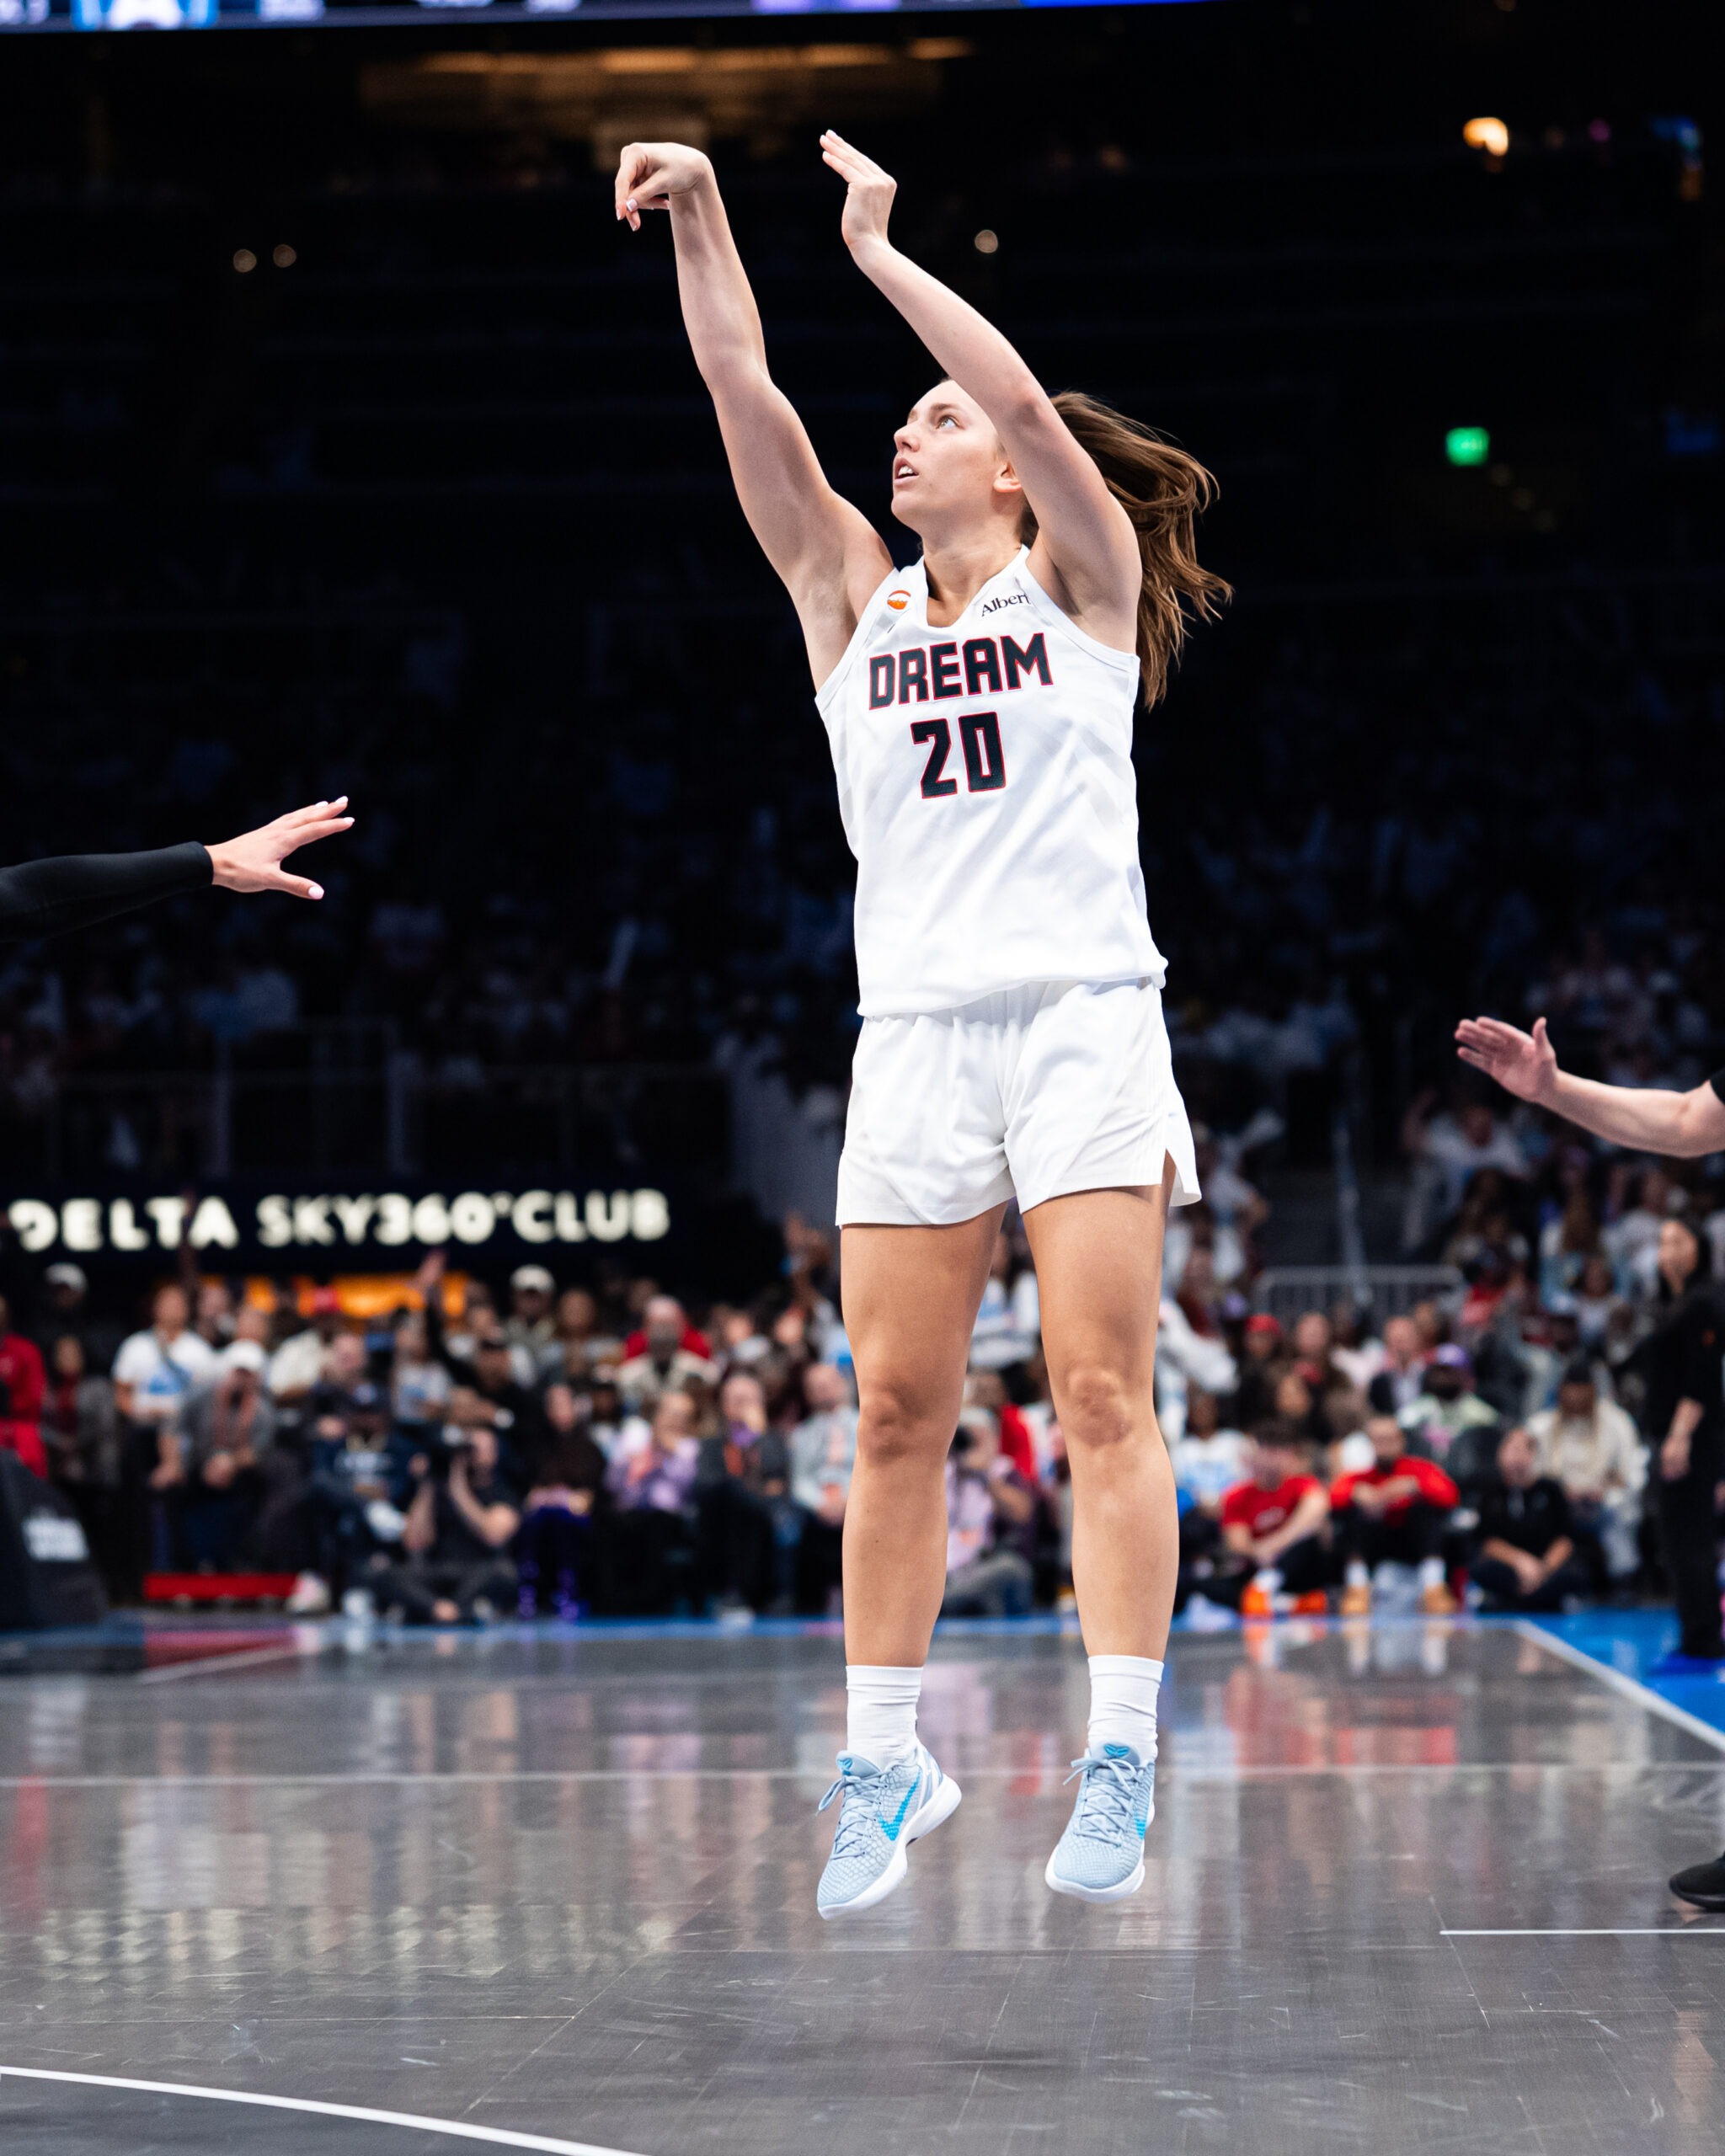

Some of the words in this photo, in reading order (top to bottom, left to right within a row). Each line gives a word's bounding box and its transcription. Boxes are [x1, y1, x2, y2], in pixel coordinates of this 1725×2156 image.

[868, 632, 1054, 710] DREAM
[910, 712, 1007, 799] 20
[8, 1196, 238, 1251] DELTA
[511, 1189, 670, 1243] CLUB
